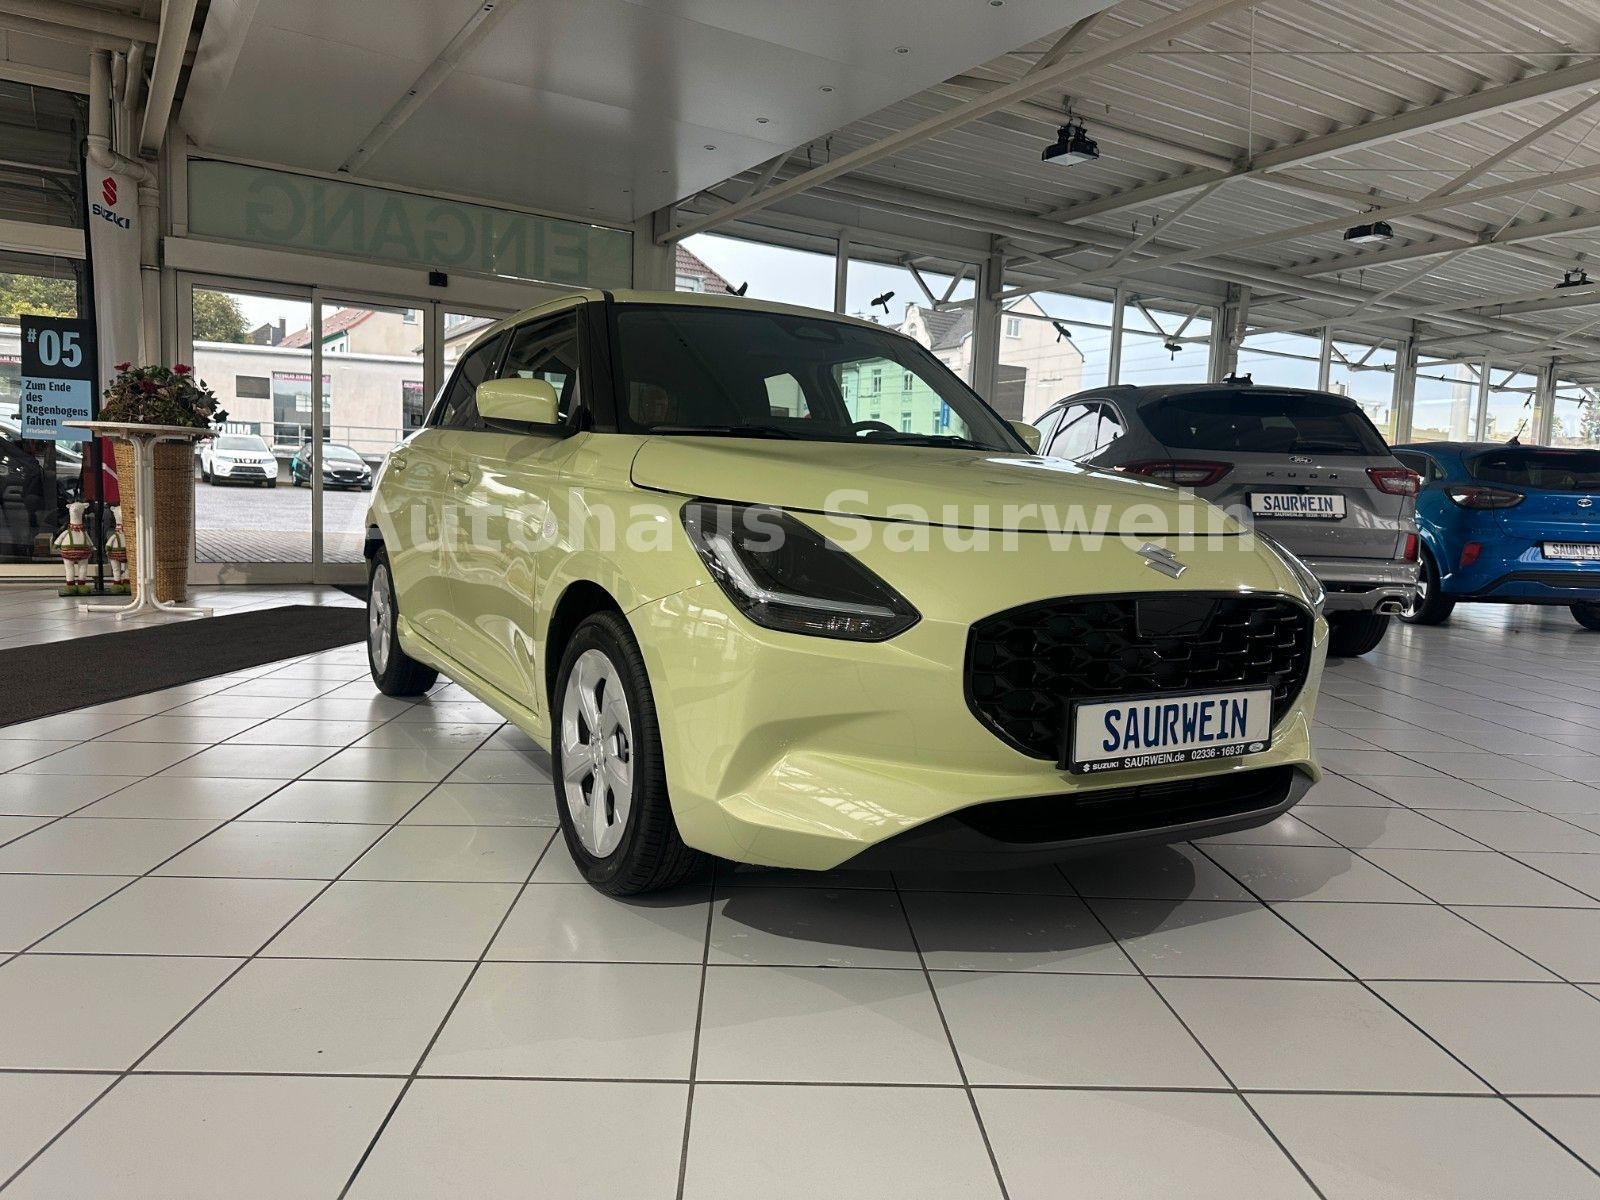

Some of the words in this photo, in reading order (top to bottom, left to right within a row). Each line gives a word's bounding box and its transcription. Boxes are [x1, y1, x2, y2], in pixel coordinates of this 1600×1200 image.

[27, 328, 82, 368] #05
[25, 380, 46, 390] Zum
[49, 381, 71, 392] Ende
[25, 392, 43, 402] des
[26, 404, 88, 417] Regenbogens
[26, 416, 57, 427] fahren
[1263, 495, 1333, 512] SAURWEIN
[1102, 697, 1248, 752] SAURWEIN
[1092, 761, 1119, 770] SUZUKI
[1124, 753, 1186, 768] SAURWEIN.de
